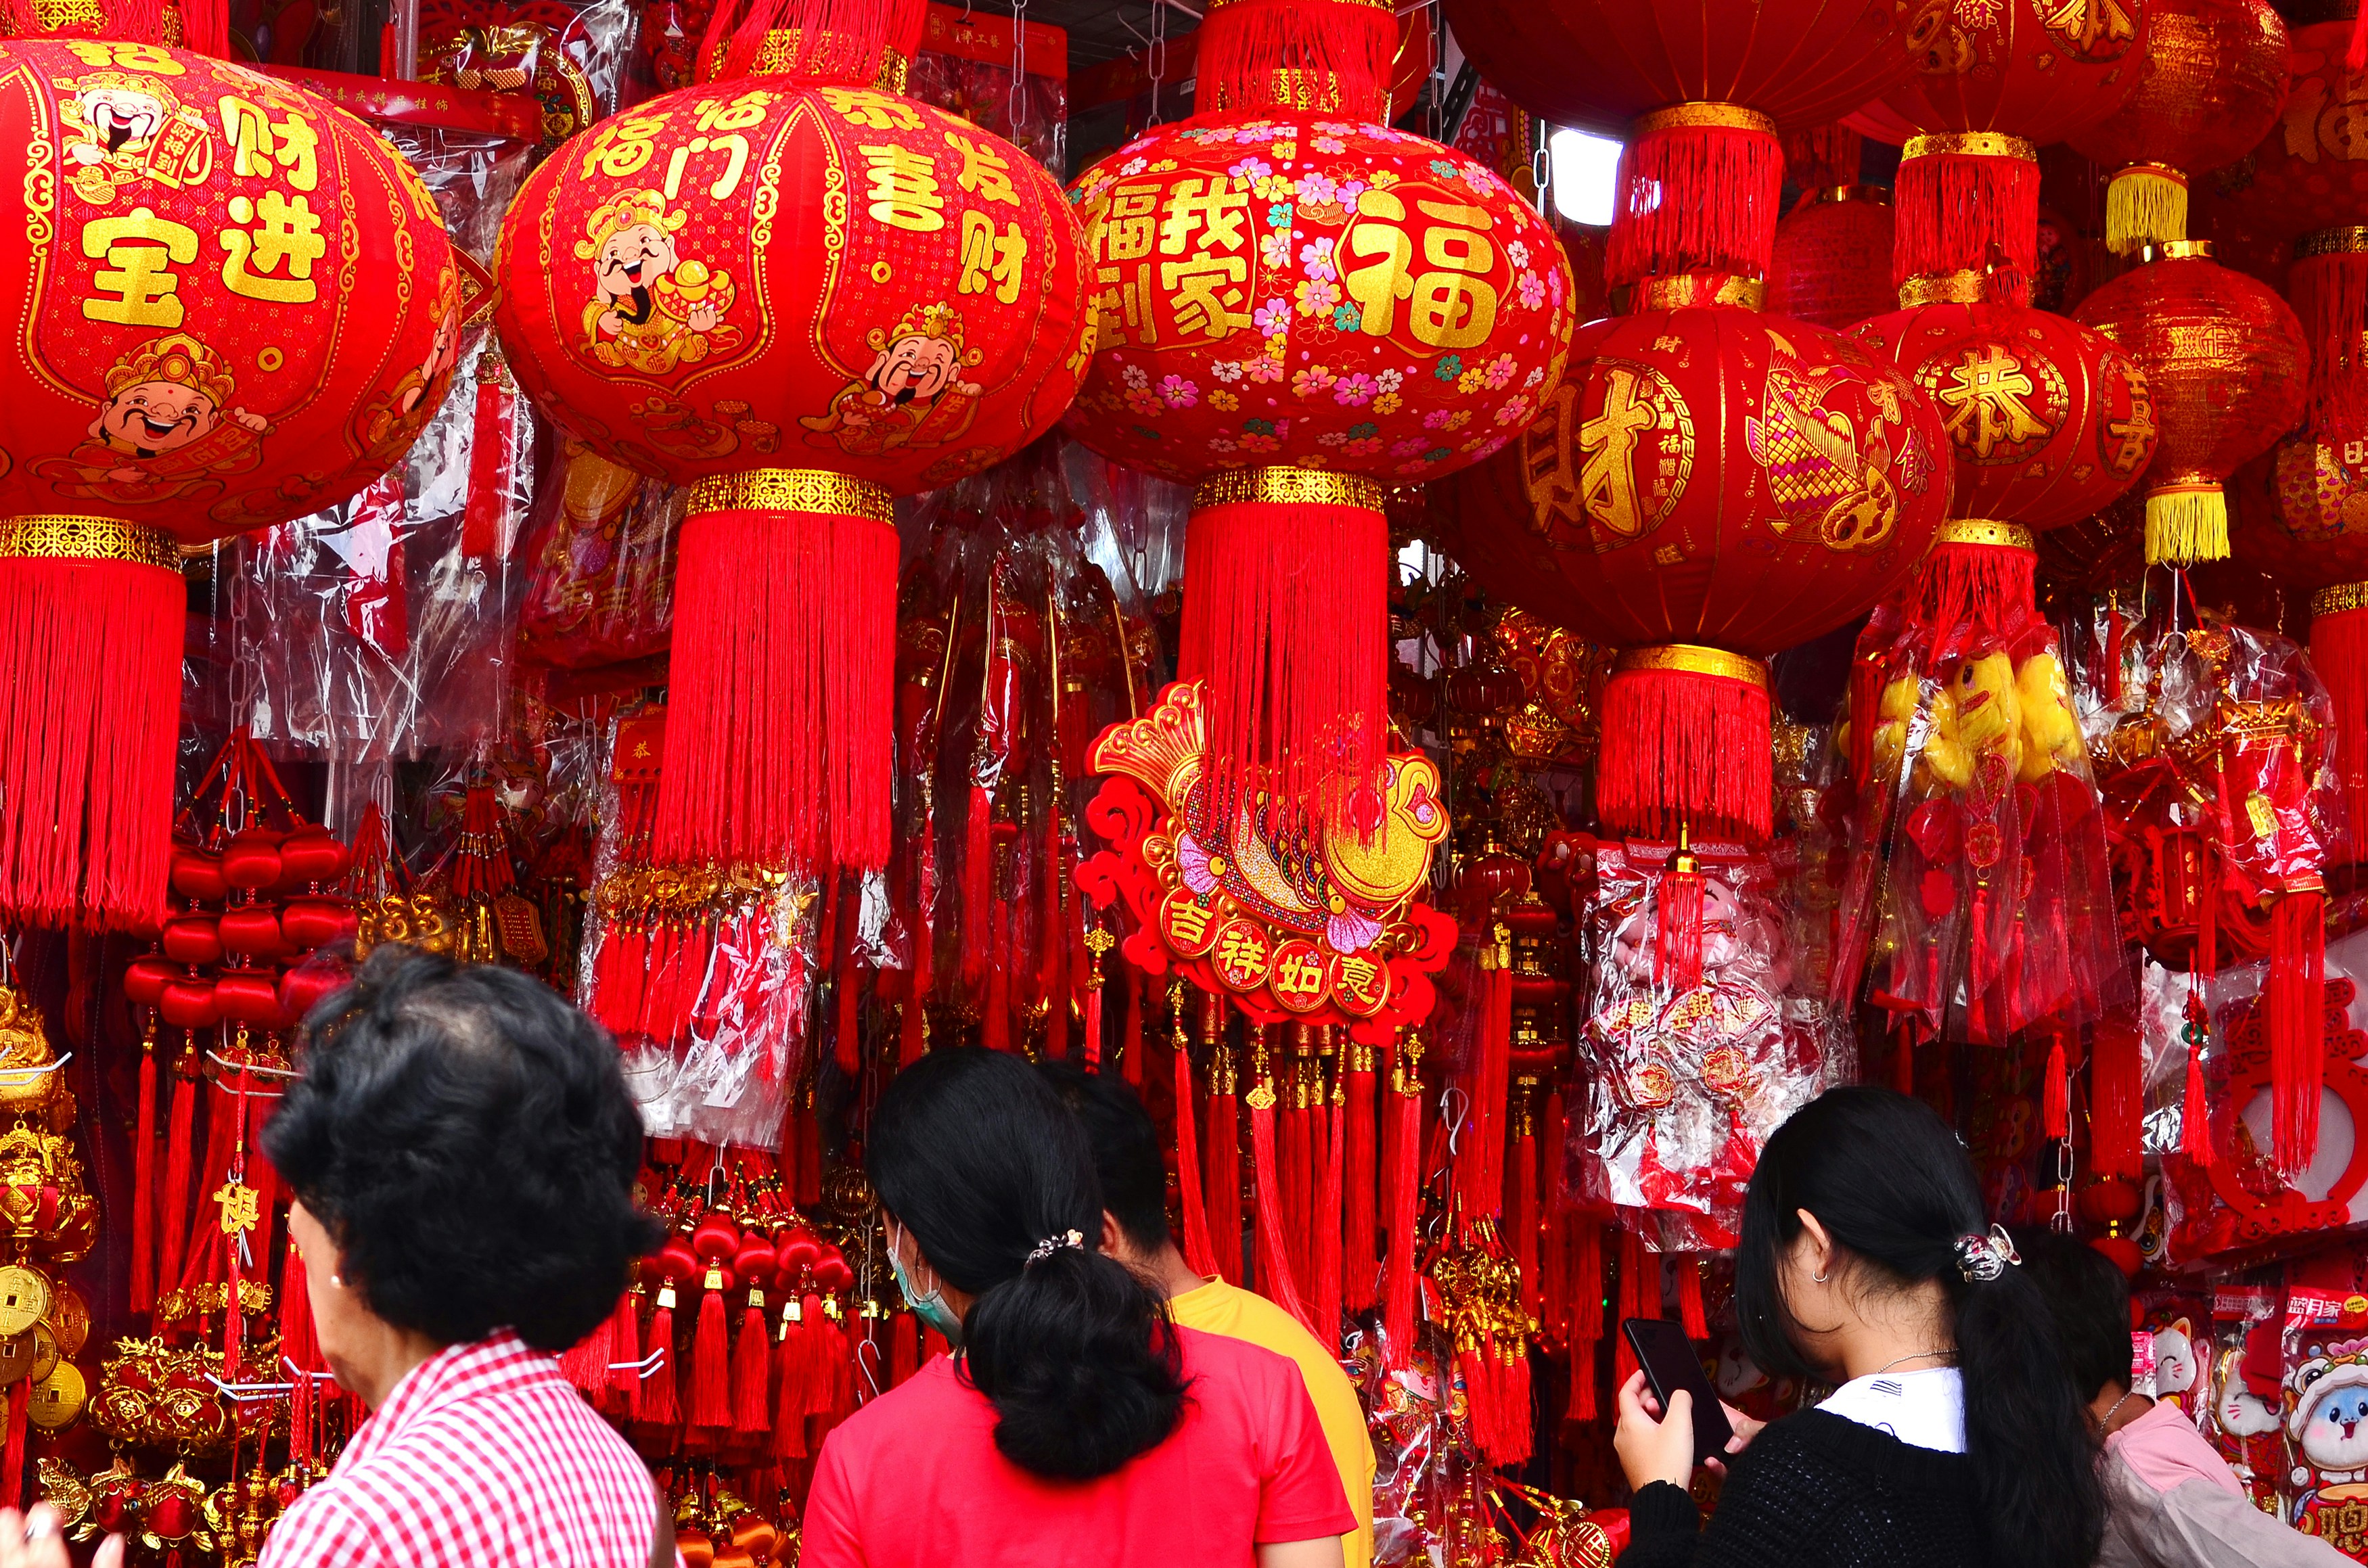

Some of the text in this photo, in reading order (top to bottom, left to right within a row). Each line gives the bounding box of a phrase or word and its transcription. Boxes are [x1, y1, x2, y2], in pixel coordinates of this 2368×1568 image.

[155, 121, 196, 176] 财神到
[580, 112, 673, 181] 福
[82, 207, 199, 328] 宝
[1346, 189, 1495, 349] 福
[1519, 368, 1658, 536] 財
[1939, 340, 2054, 459] 恭
[2287, 1295, 2342, 1318] 蓝月家
